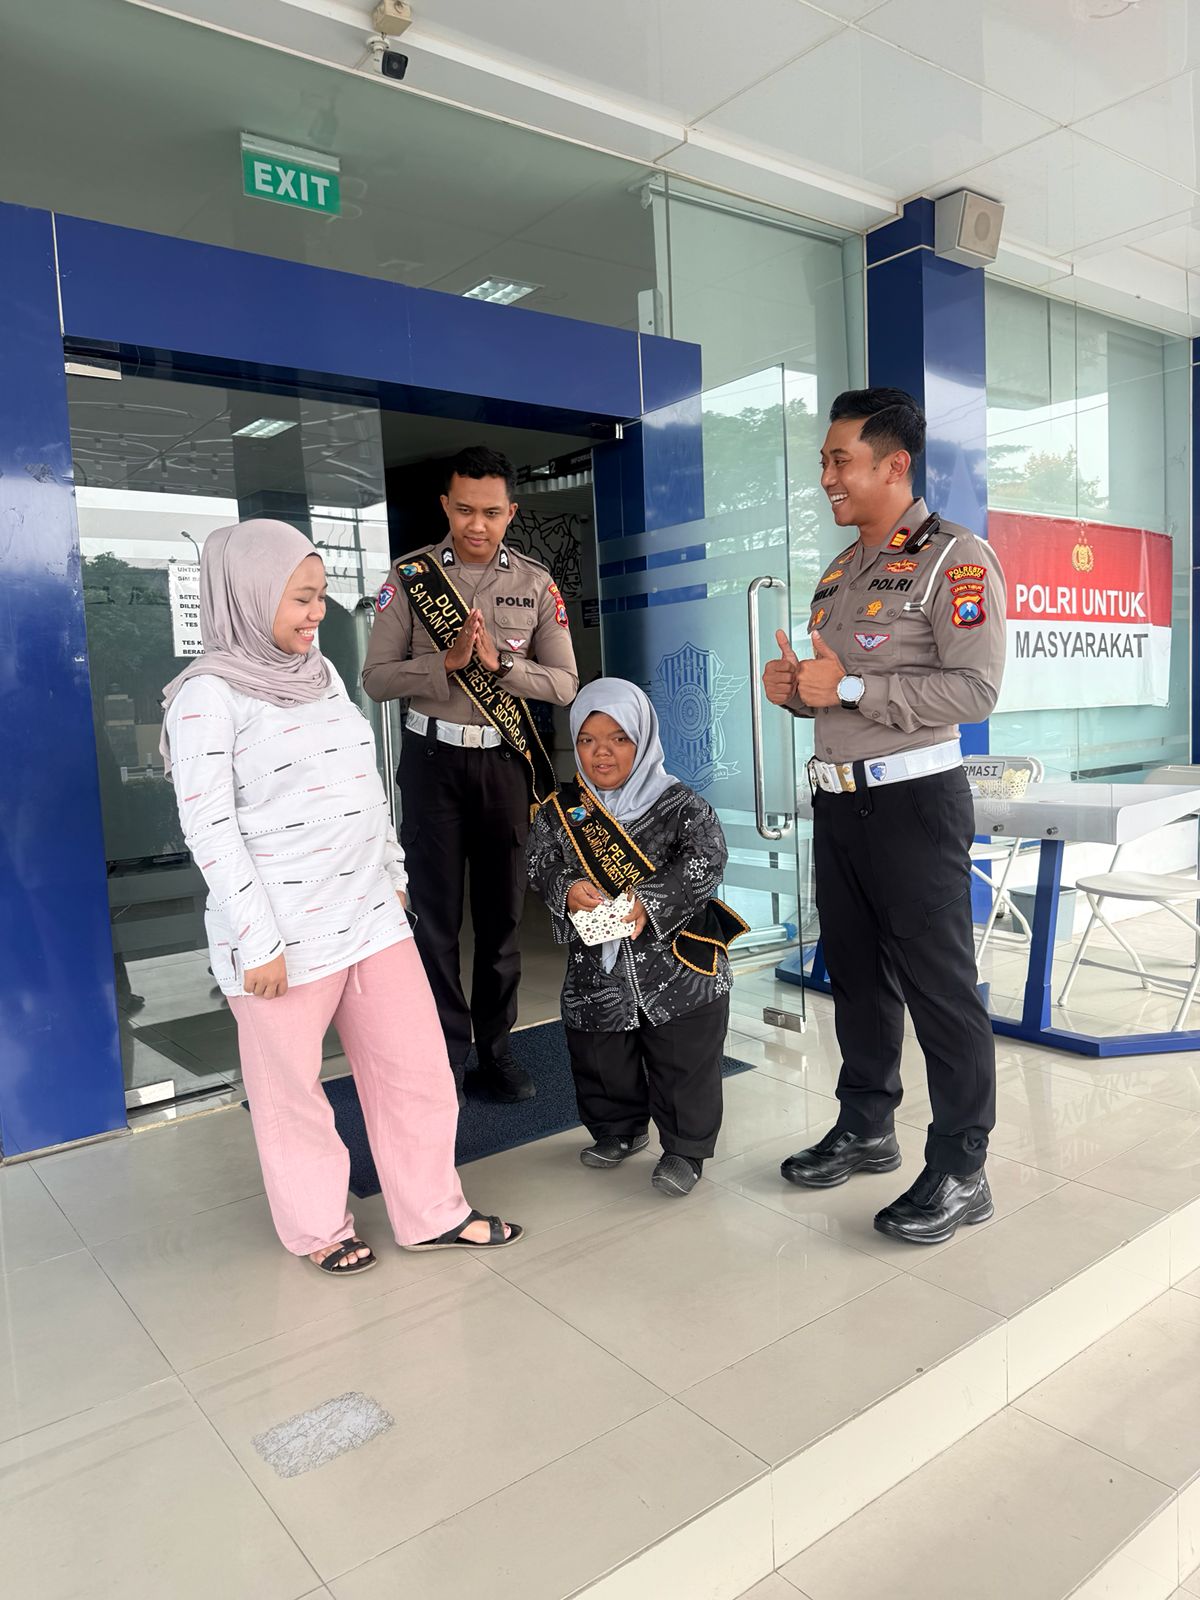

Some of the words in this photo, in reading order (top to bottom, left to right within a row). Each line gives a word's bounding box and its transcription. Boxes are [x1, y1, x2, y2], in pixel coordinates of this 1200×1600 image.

[254, 161, 330, 206] EXIT
[550, 461, 556, 474] 2
[949, 565, 984, 577] POLRESTA
[867, 578, 914, 592] POLRI
[496, 597, 534, 608] POLRI
[1015, 584, 1077, 614] POLRI
[1082, 588, 1146, 618] UNTUK
[1015, 631, 1148, 658] MASYARAKAT
[410, 583, 456, 648] SATLANTAS
[493, 703, 526, 751] SIDOARJO
[582, 822, 606, 858] SATLANTAS
[600, 854, 627, 889] POLRESTA
